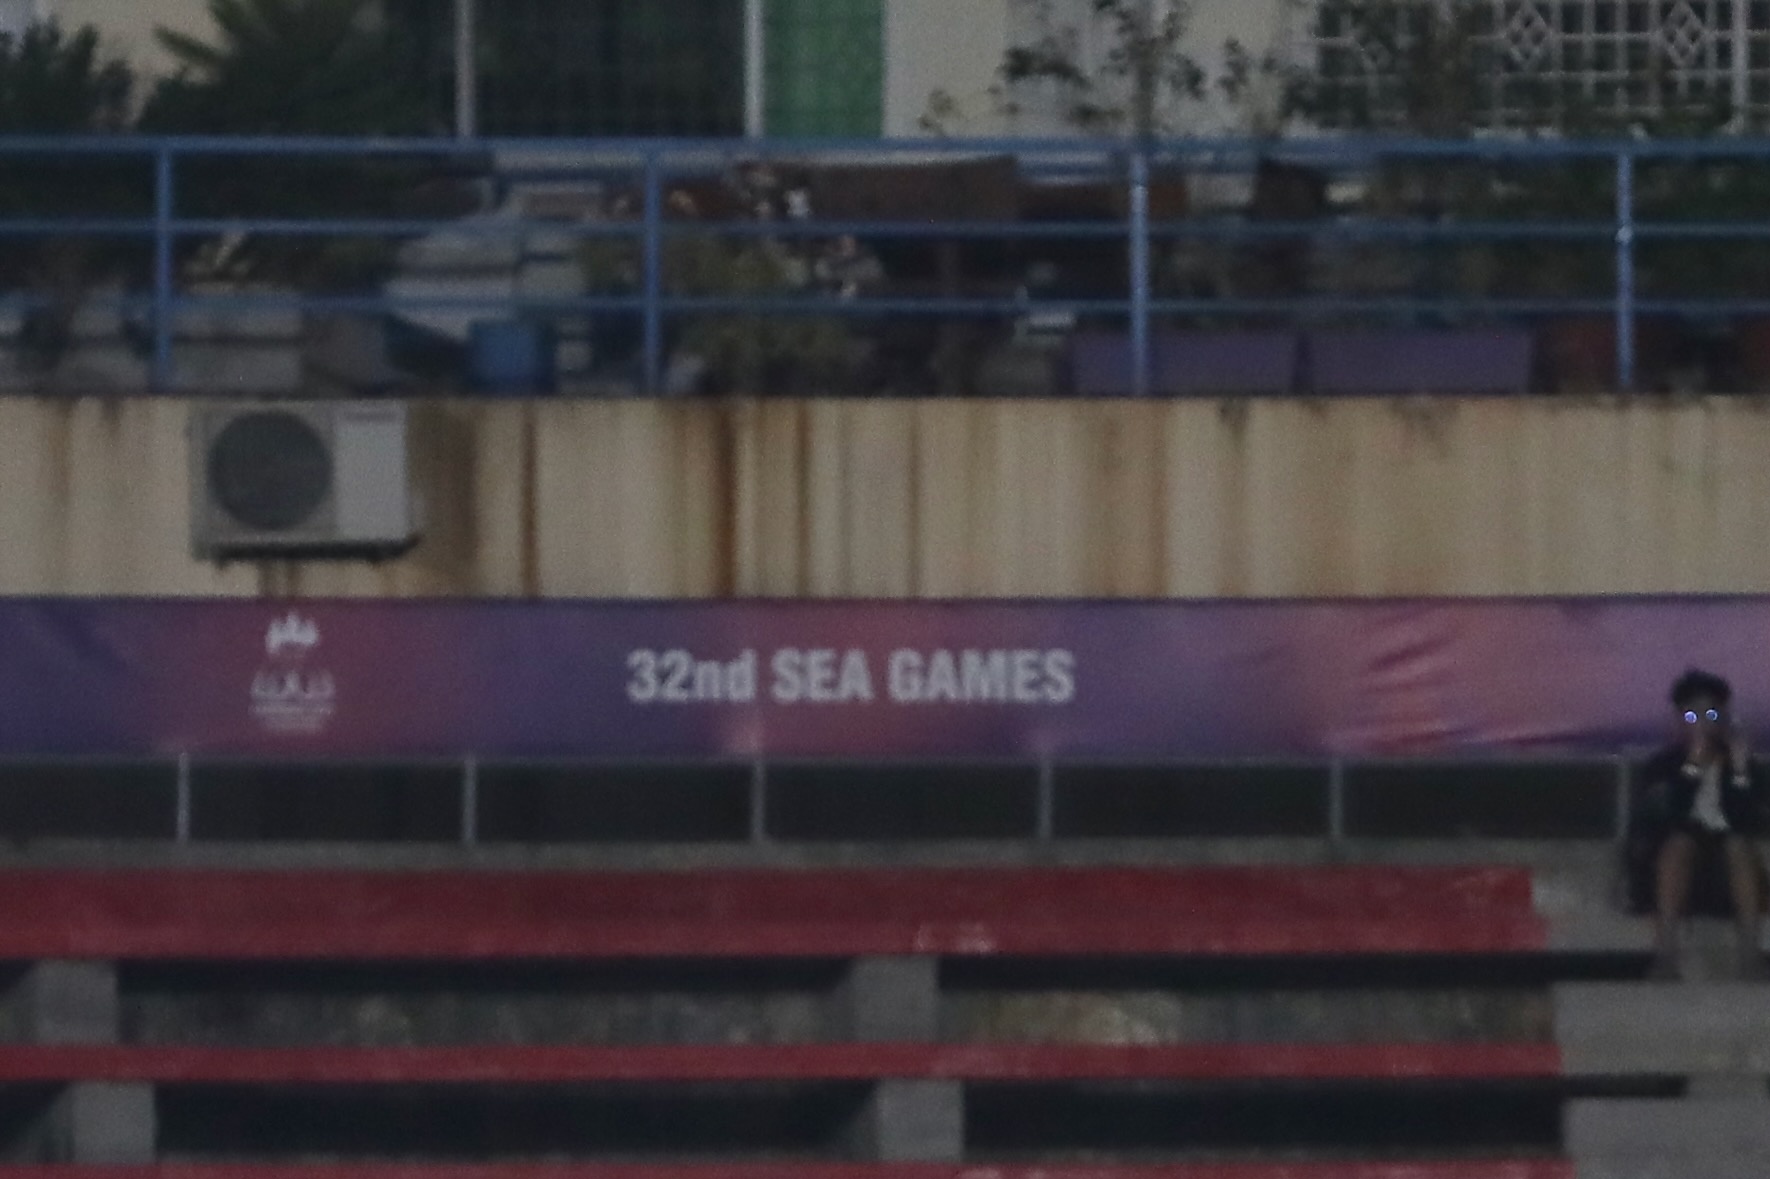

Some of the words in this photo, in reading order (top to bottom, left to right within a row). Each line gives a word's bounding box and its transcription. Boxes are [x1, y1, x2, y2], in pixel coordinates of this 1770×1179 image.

[626, 648, 757, 702] 32nd
[770, 648, 873, 702] SEA
[888, 648, 1076, 703] GAMES
